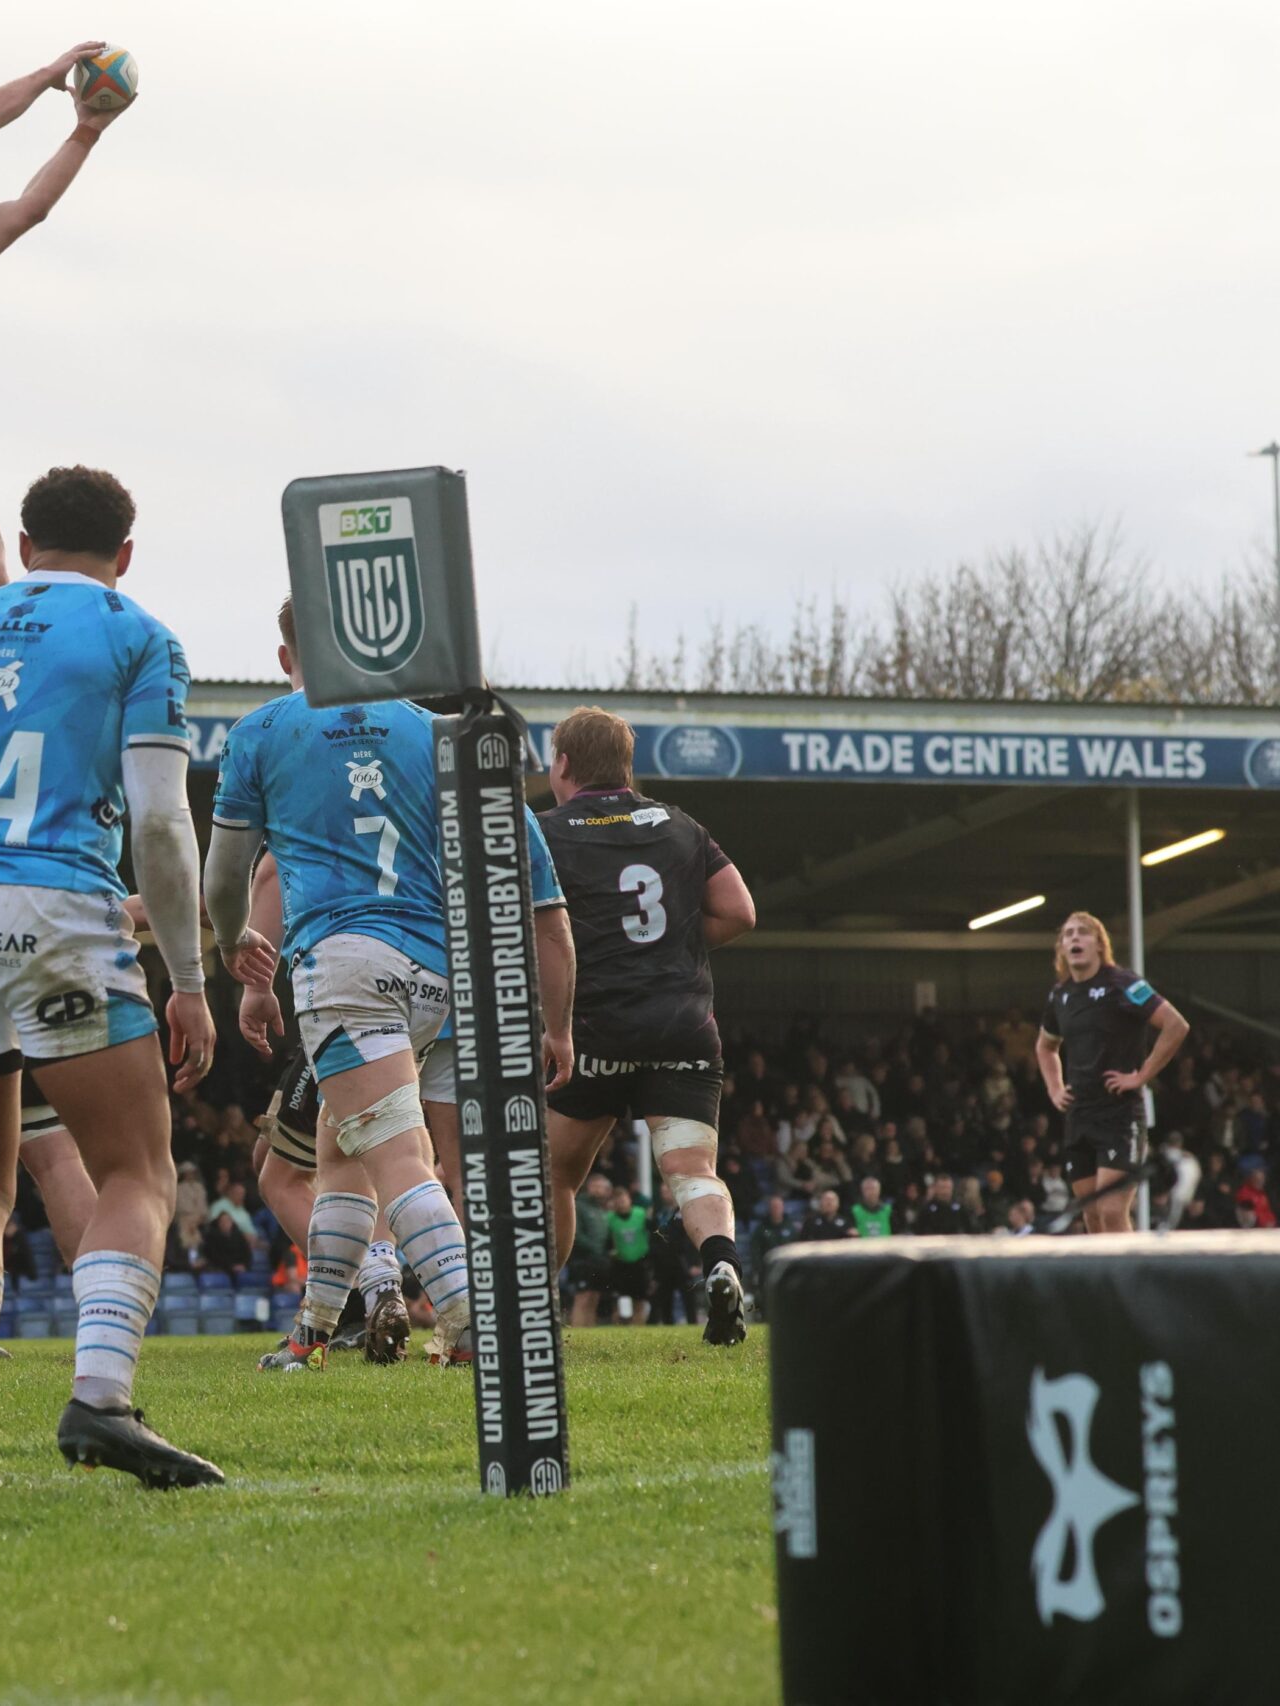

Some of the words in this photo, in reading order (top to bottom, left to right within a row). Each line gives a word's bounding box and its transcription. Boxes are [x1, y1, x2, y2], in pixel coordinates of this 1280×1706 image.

[341, 507, 390, 535] BKT
[321, 725, 390, 740] VALLEY
[353, 772, 379, 784] 1664
[782, 733, 914, 773] TRADE
[923, 736, 1069, 777] CENTRE
[1077, 740, 1207, 779] WALES
[568, 818, 585, 826] the
[353, 815, 400, 897] 7
[619, 863, 667, 943] 3
[440, 790, 479, 1081] UNITEDRUGBY.COM
[480, 786, 532, 1078] UNITEDRUGBY.COM
[36, 990, 96, 1026] GD
[375, 978, 418, 995] DAVD
[289, 1079, 308, 1111] DOOM
[465, 1152, 503, 1443] UNITEDRUGBY.COM
[508, 1148, 558, 1441] UNITEDRUGBY.COM
[1139, 1360, 1182, 1638] OSPREYS
